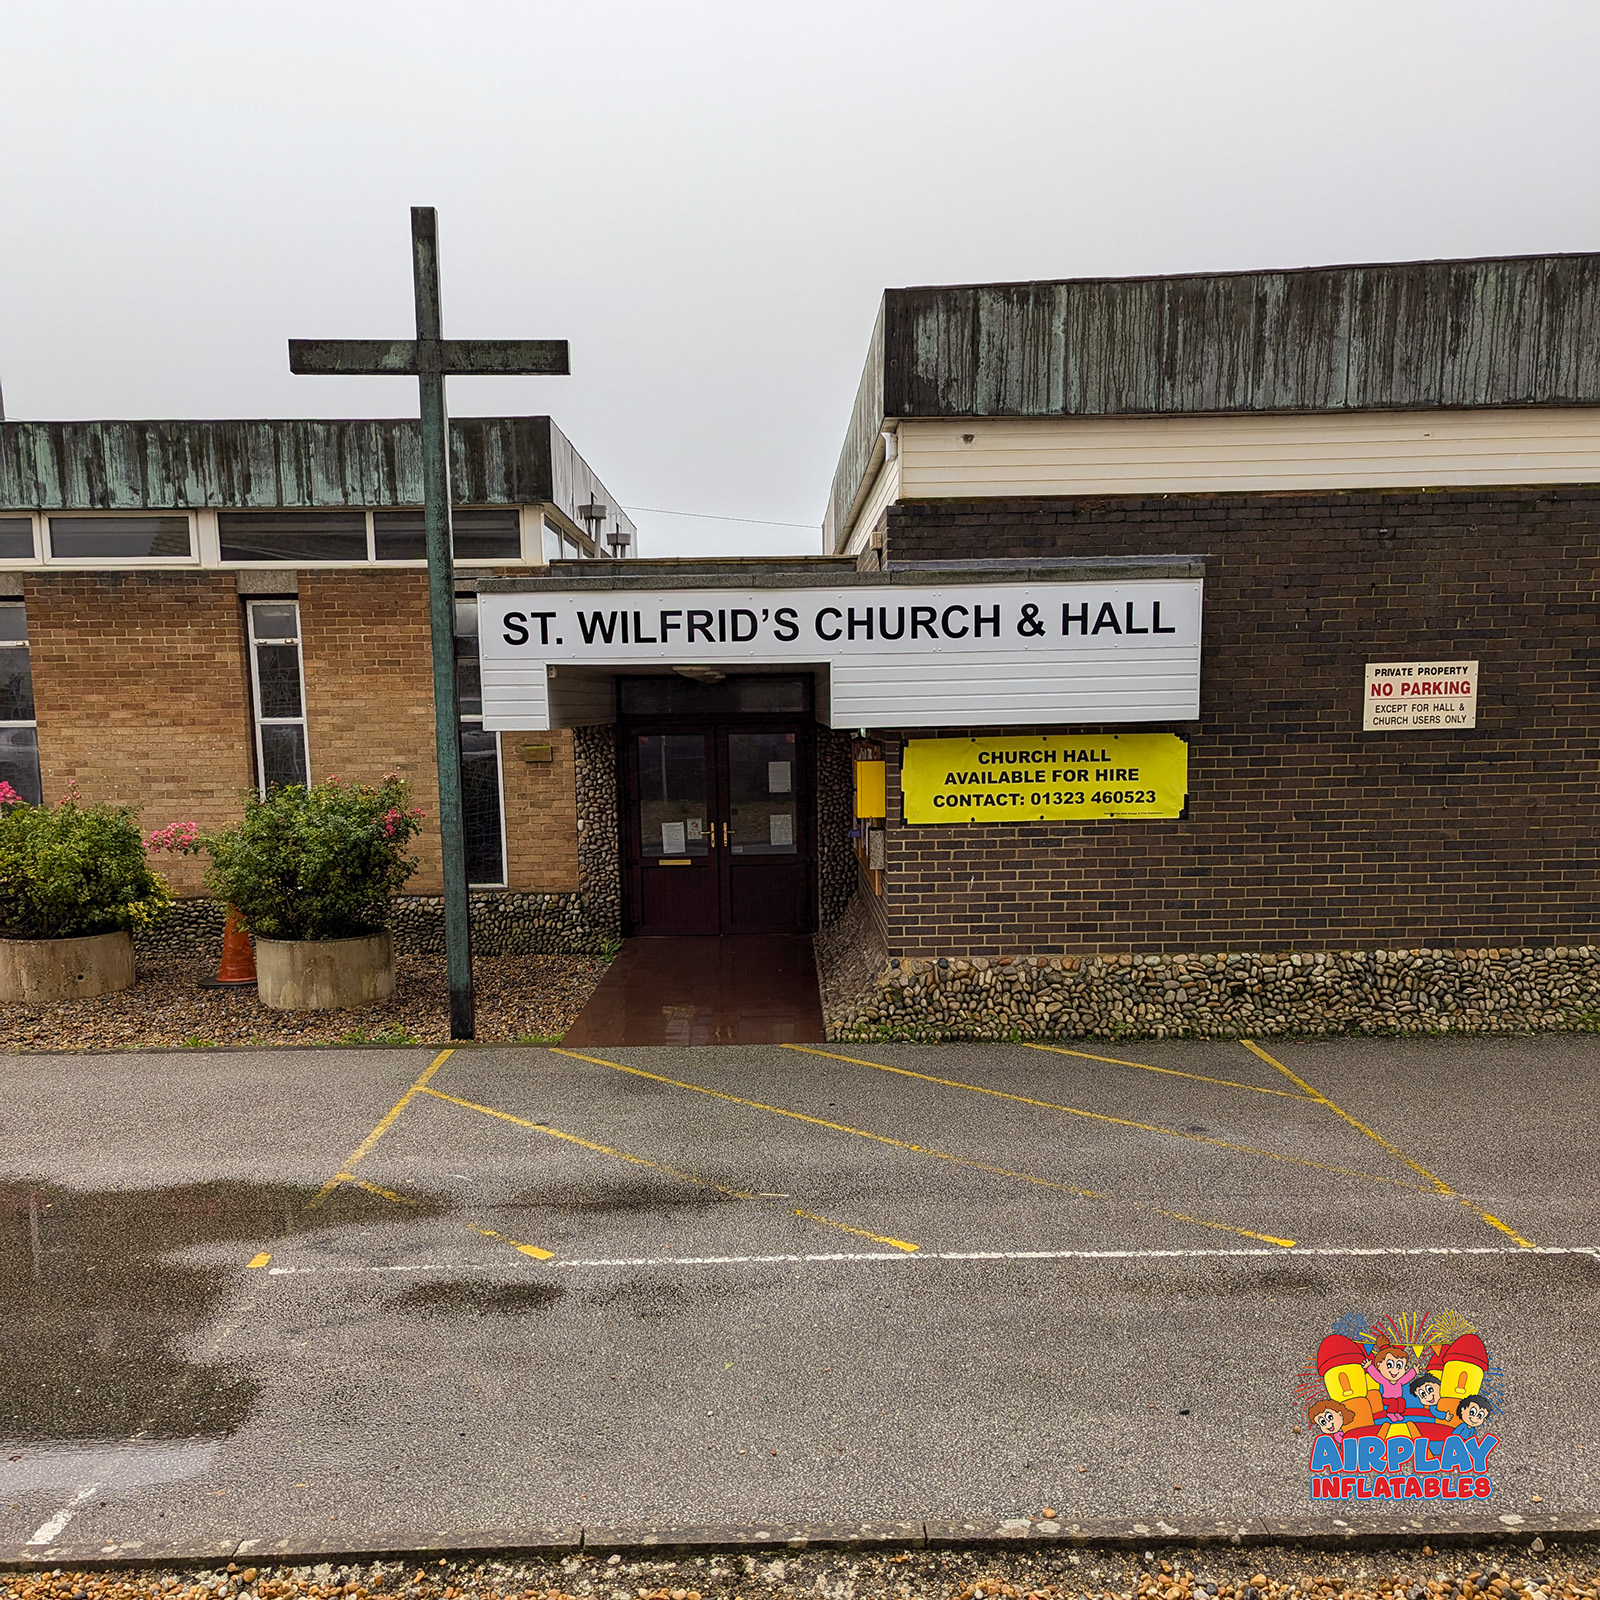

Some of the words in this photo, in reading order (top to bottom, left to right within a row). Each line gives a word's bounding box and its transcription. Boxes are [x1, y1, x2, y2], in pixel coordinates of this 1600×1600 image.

[502, 611, 564, 646] ST.
[576, 607, 801, 645] WILFRID’S
[814, 603, 1001, 641] CHURCH
[1016, 602, 1047, 637] &
[1061, 601, 1176, 636] HALL
[1374, 667, 1413, 677] PRIVATE
[1418, 666, 1469, 676] PROPERTY
[1370, 683, 1393, 697] NO
[1400, 680, 1471, 696] PARKING
[1375, 704, 1408, 713] EXCEPT
[1411, 703, 1429, 712] FOR
[1433, 703, 1455, 712] HALL
[1458, 702, 1465, 711] &
[1372, 716, 1408, 726] CHURCH
[1412, 715, 1441, 724] USERS
[1444, 714, 1467, 723] ONLY
[978, 750, 1057, 765] CHURCH
[1063, 749, 1112, 763] HALL
[944, 770, 1046, 785] AVAILABLE
[1052, 769, 1090, 783] FOR
[1095, 768, 1139, 782] HIRE
[933, 793, 1025, 808] CONTACT:
[1030, 791, 1085, 806] 01323
[1090, 790, 1156, 804] 460523
